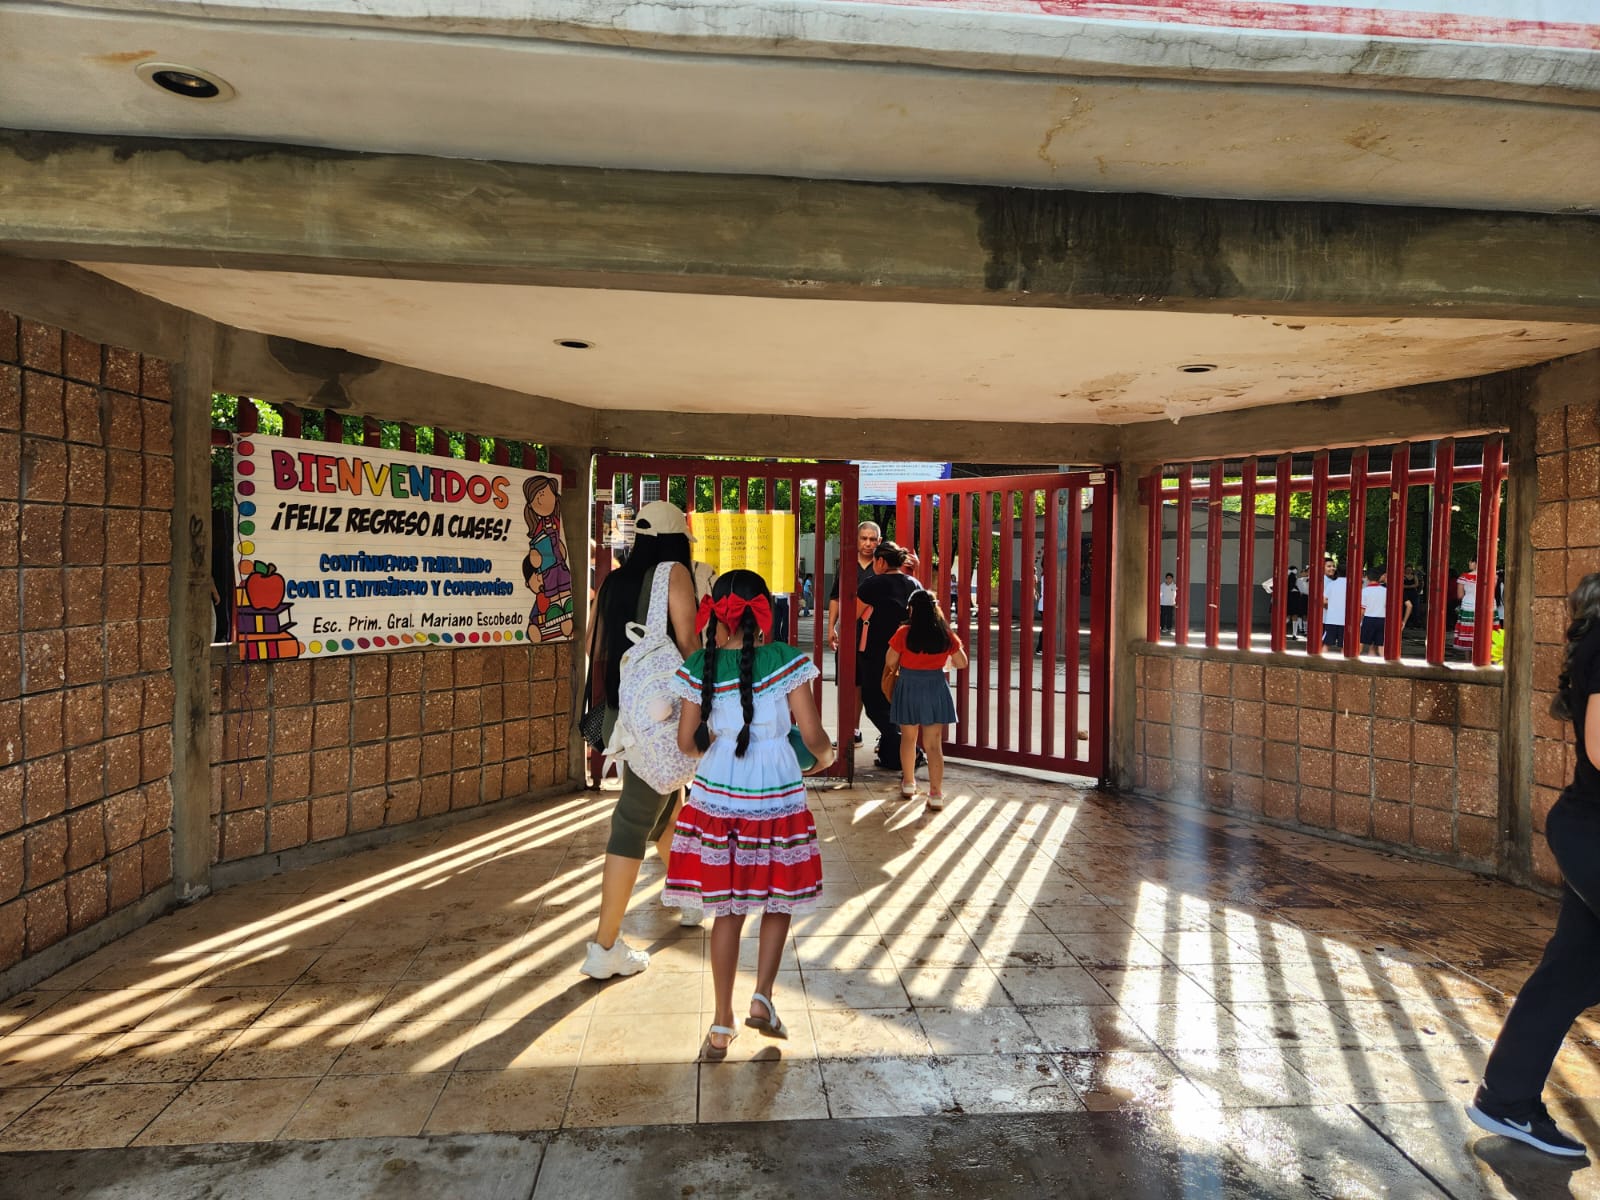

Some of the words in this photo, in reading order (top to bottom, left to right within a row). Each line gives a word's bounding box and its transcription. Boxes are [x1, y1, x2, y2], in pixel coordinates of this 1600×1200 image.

[271, 450, 511, 509] BIENVENIDOS
[271, 502, 342, 533] ¡FELIZ
[345, 507, 430, 536] REGRESO
[432, 514, 445, 537] A
[448, 515, 512, 541] CLASES!
[287, 580, 320, 599] CON
[323, 579, 343, 598] EL
[431, 580, 441, 596] Y
[313, 616, 342, 634] Esc.
[348, 615, 382, 632] Prim.
[387, 613, 415, 629] Gral.
[421, 612, 473, 628] Mariano
[477, 611, 523, 626] Escobedo
